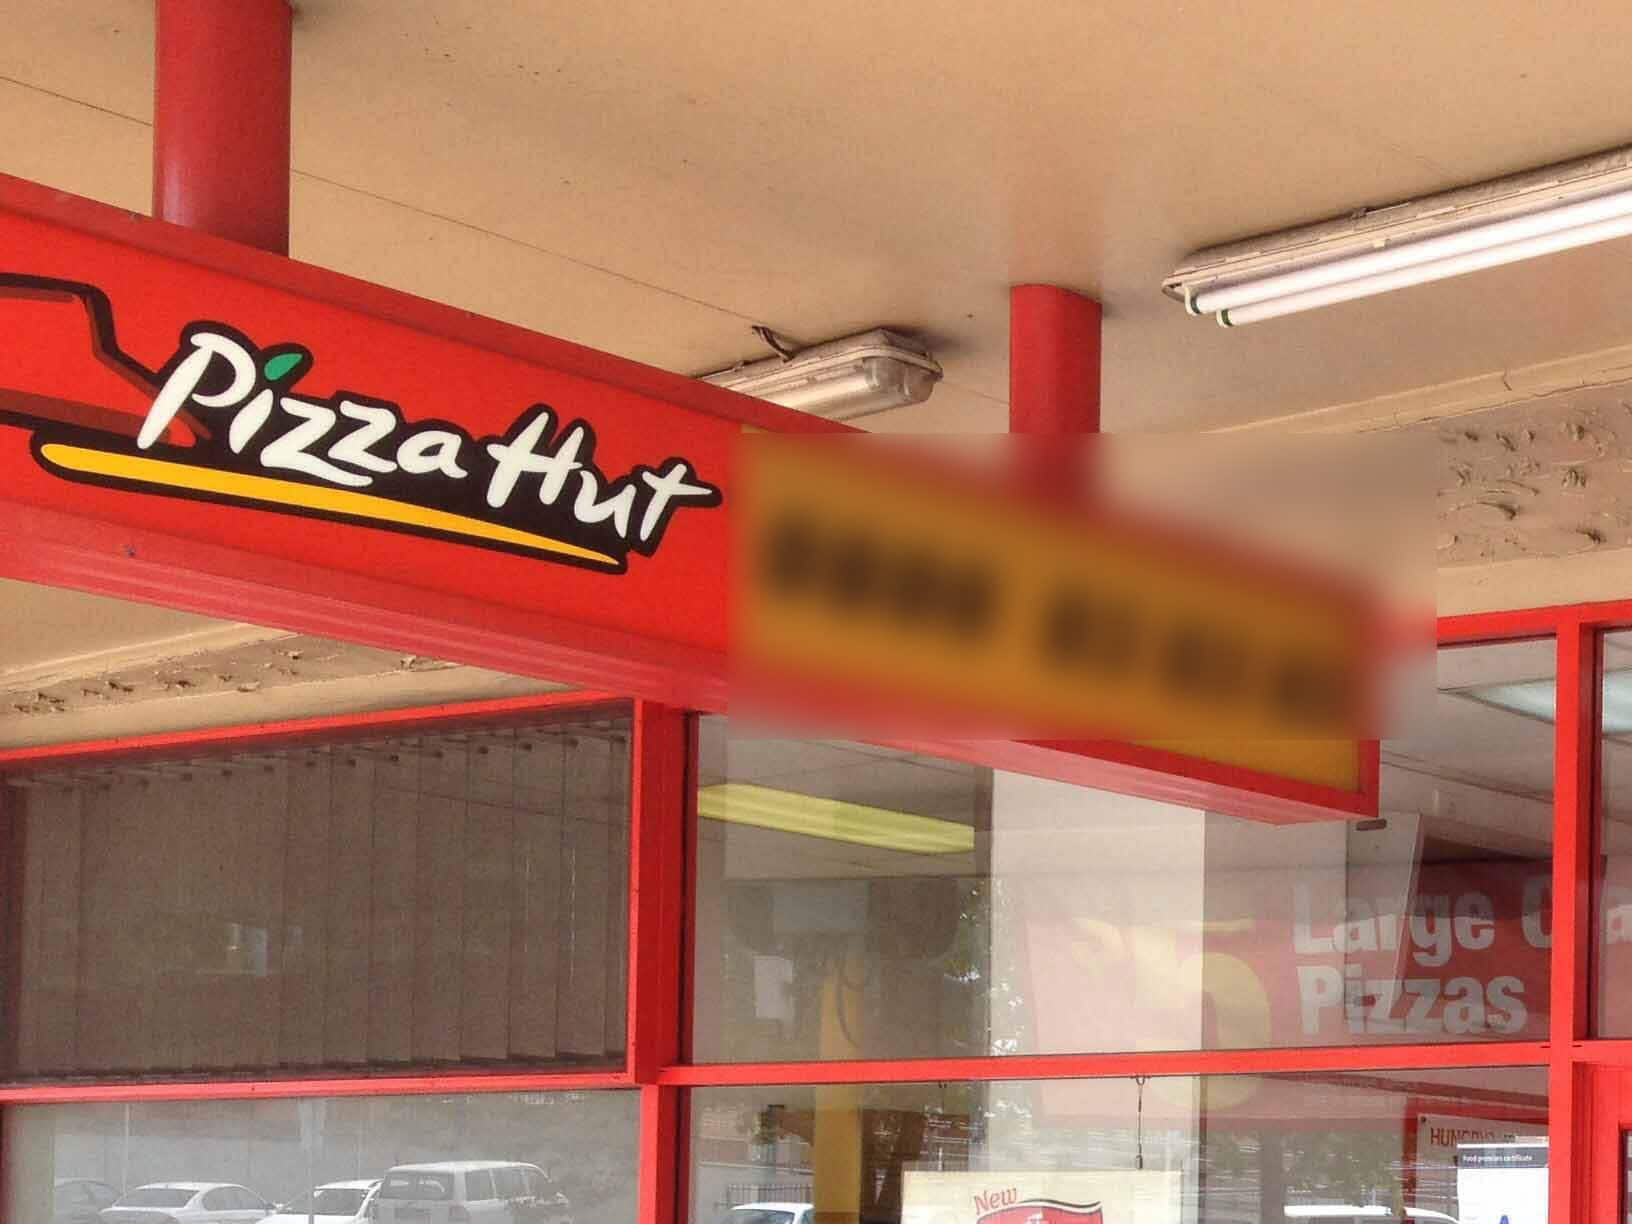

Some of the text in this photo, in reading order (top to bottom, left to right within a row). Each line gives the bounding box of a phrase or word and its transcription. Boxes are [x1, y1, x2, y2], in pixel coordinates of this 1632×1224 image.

[137, 331, 713, 541] Pizza Hut
[1292, 878, 1495, 967] Large
[1297, 966, 1527, 1035] Pizzas
[974, 1187, 1017, 1215] New
